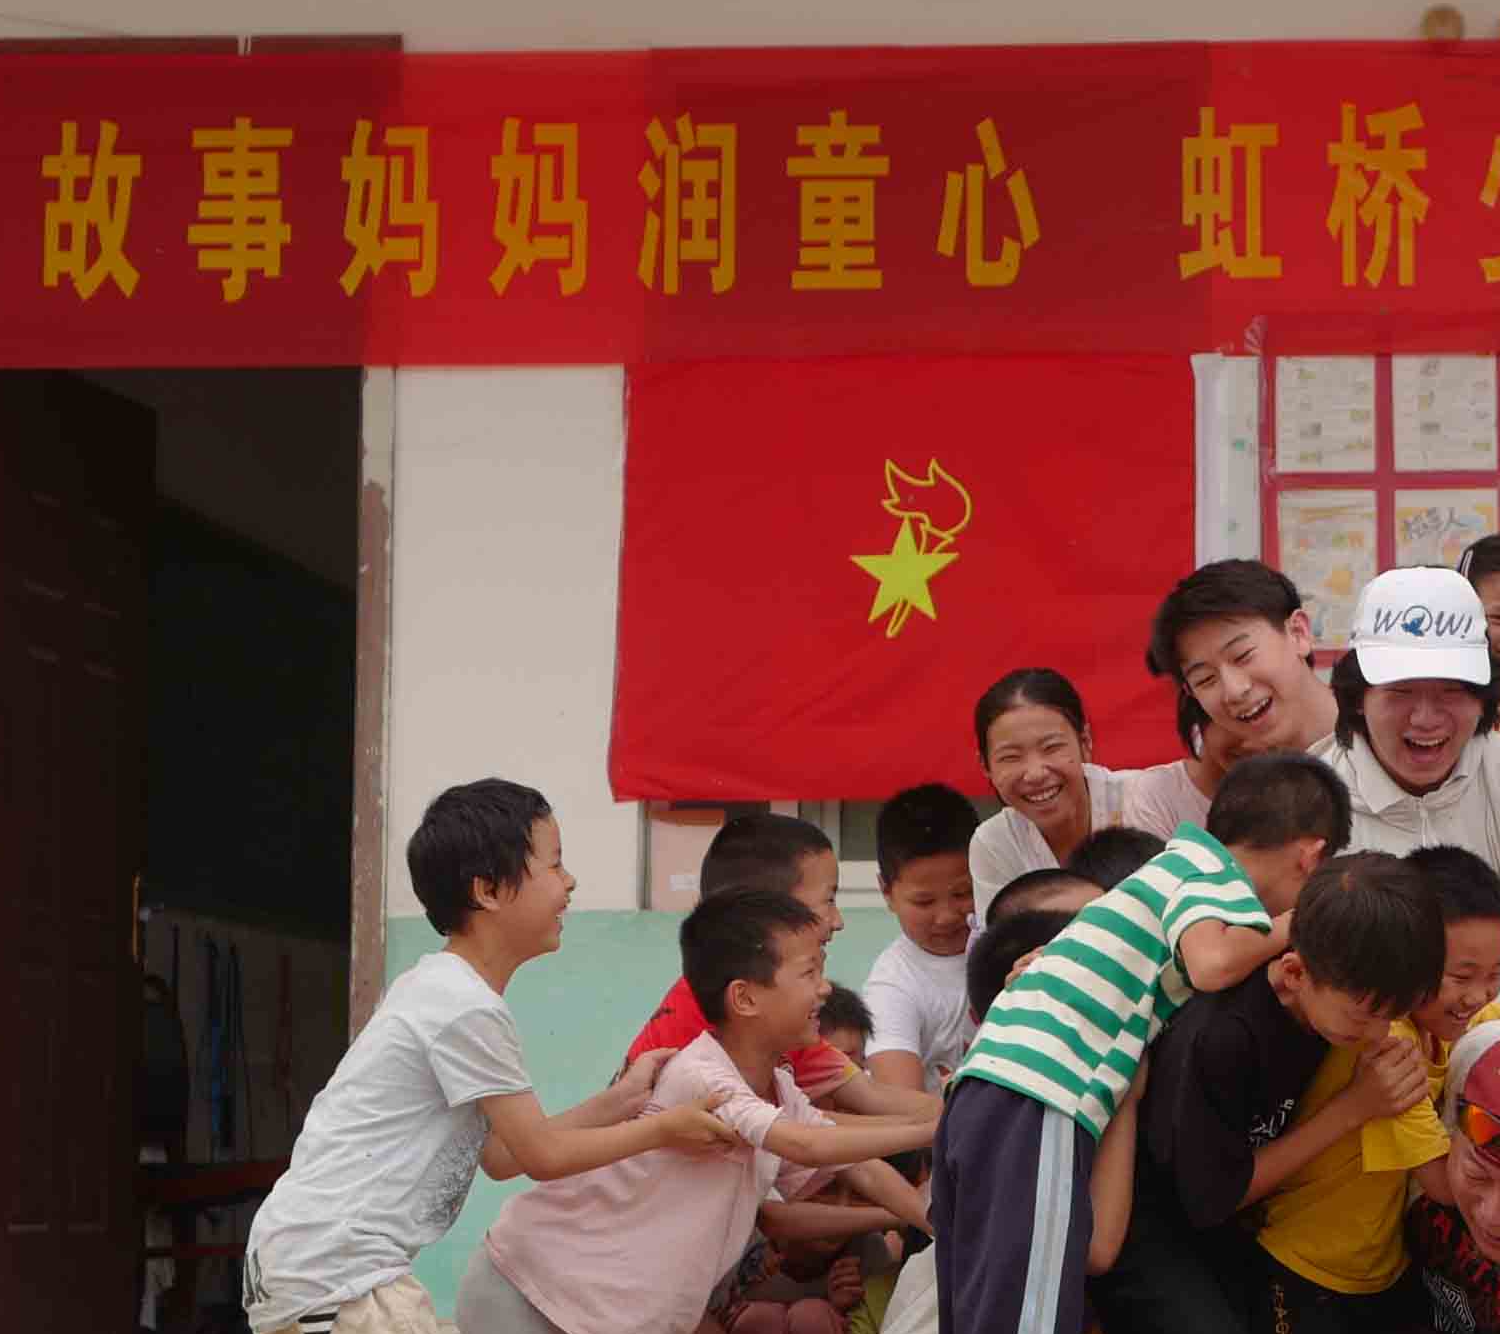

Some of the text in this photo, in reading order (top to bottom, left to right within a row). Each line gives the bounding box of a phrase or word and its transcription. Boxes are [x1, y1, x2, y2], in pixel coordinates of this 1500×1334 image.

[41, 110, 1041, 303] 故事妈妈润童心
